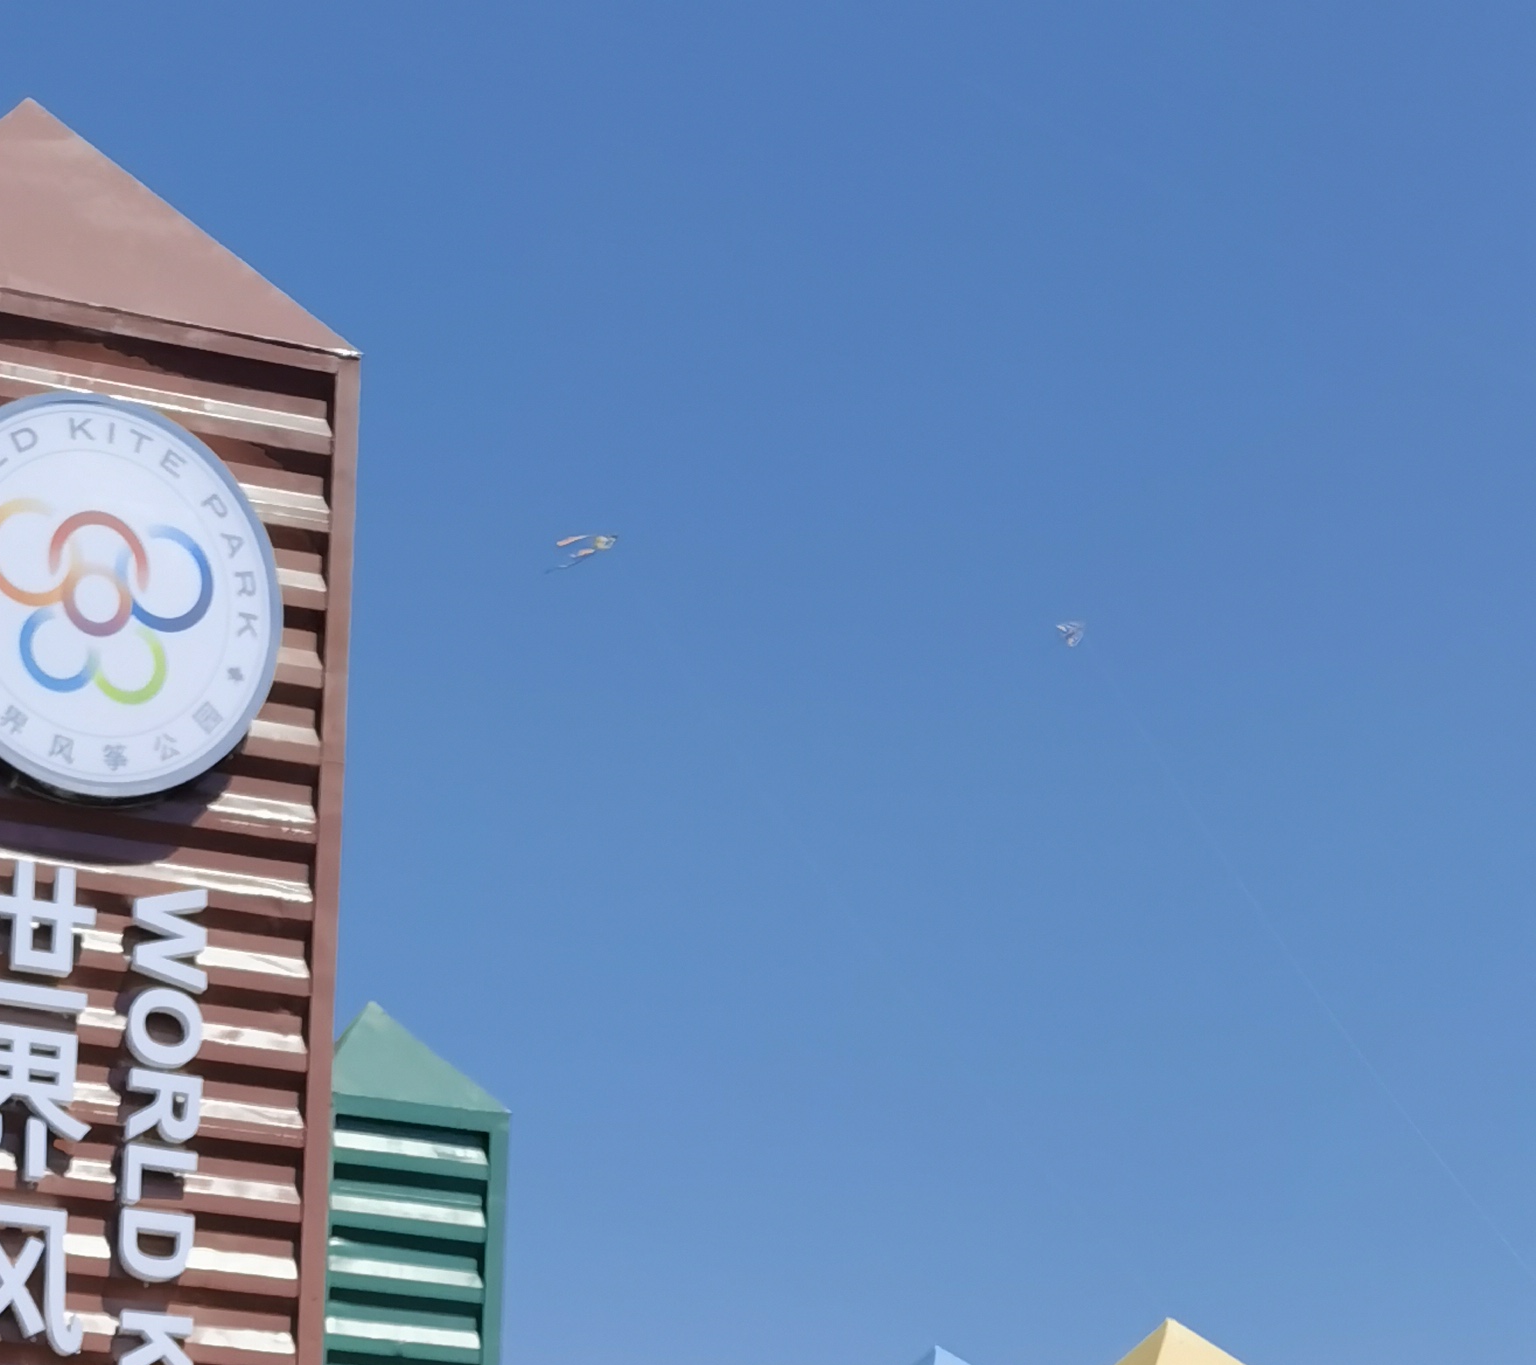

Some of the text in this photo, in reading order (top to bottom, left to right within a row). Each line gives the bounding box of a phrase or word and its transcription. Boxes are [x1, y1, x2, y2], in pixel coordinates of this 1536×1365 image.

[68, 417, 186, 479] KITE
[201, 494, 259, 639] PARK
[119, 888, 209, 1284] WORLD
